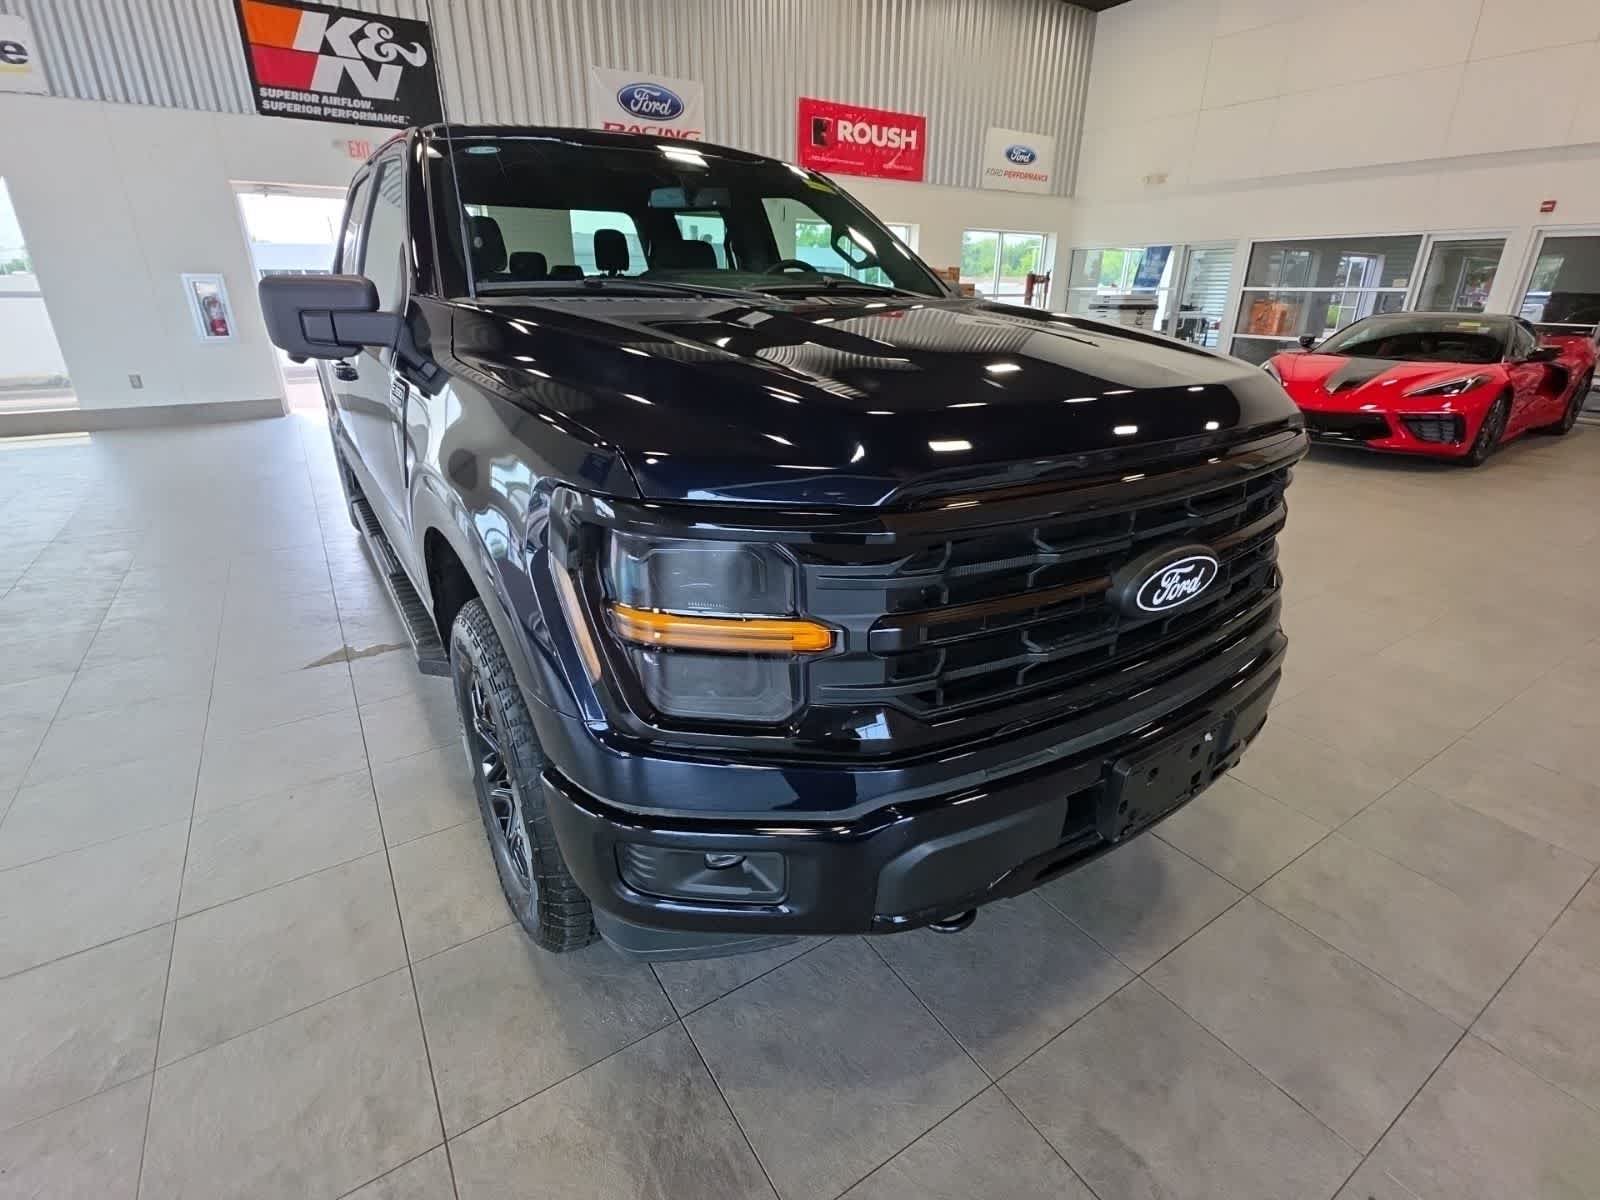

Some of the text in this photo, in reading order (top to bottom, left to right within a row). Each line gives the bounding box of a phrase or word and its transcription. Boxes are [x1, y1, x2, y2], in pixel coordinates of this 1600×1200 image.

[260, 87, 374, 110] SUPERIOR AIRFLOW.
[262, 100, 321, 116] SUPERIOR
[630, 88, 672, 115] Ford
[837, 119, 917, 150] ROUSH
[1152, 564, 1205, 605] Ford
